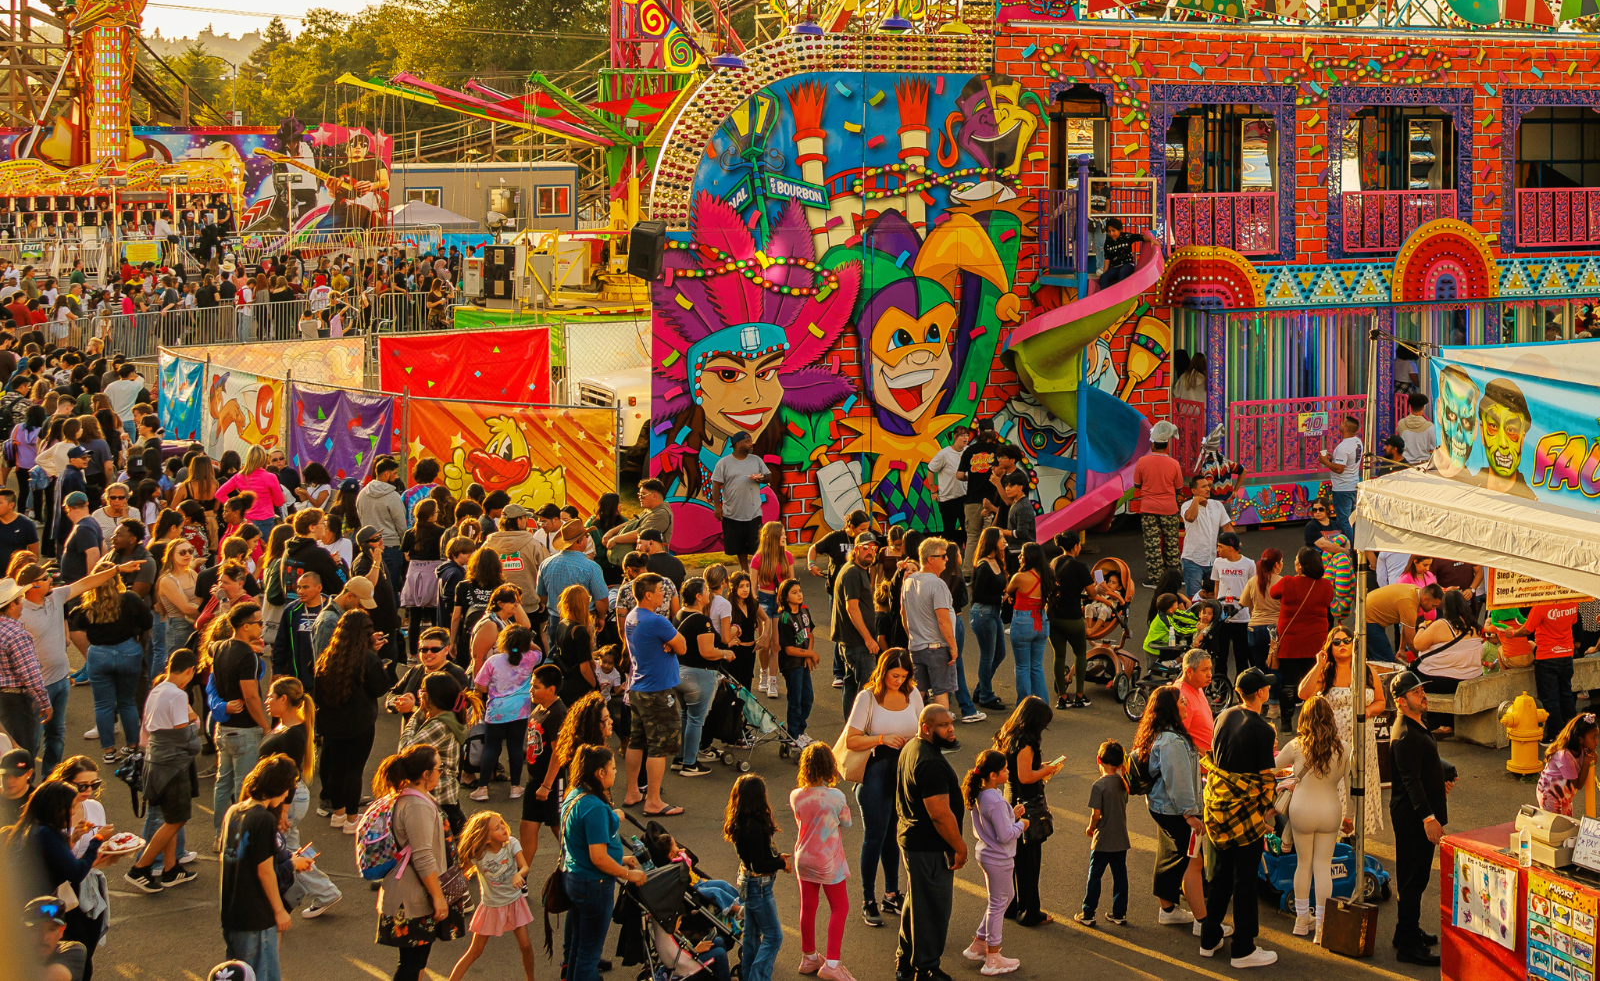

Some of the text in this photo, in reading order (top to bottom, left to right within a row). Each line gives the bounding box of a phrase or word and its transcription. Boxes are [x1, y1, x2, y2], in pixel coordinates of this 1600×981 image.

[728, 187, 748, 208] NAL
[776, 180, 823, 203] BOURBON
[1304, 416, 1322, 431] 10
[1496, 571, 1510, 580] Step
[1496, 587, 1509, 595] Step
[1586, 839, 1598, 848] PAY
[1548, 882, 1574, 899] MASKS
